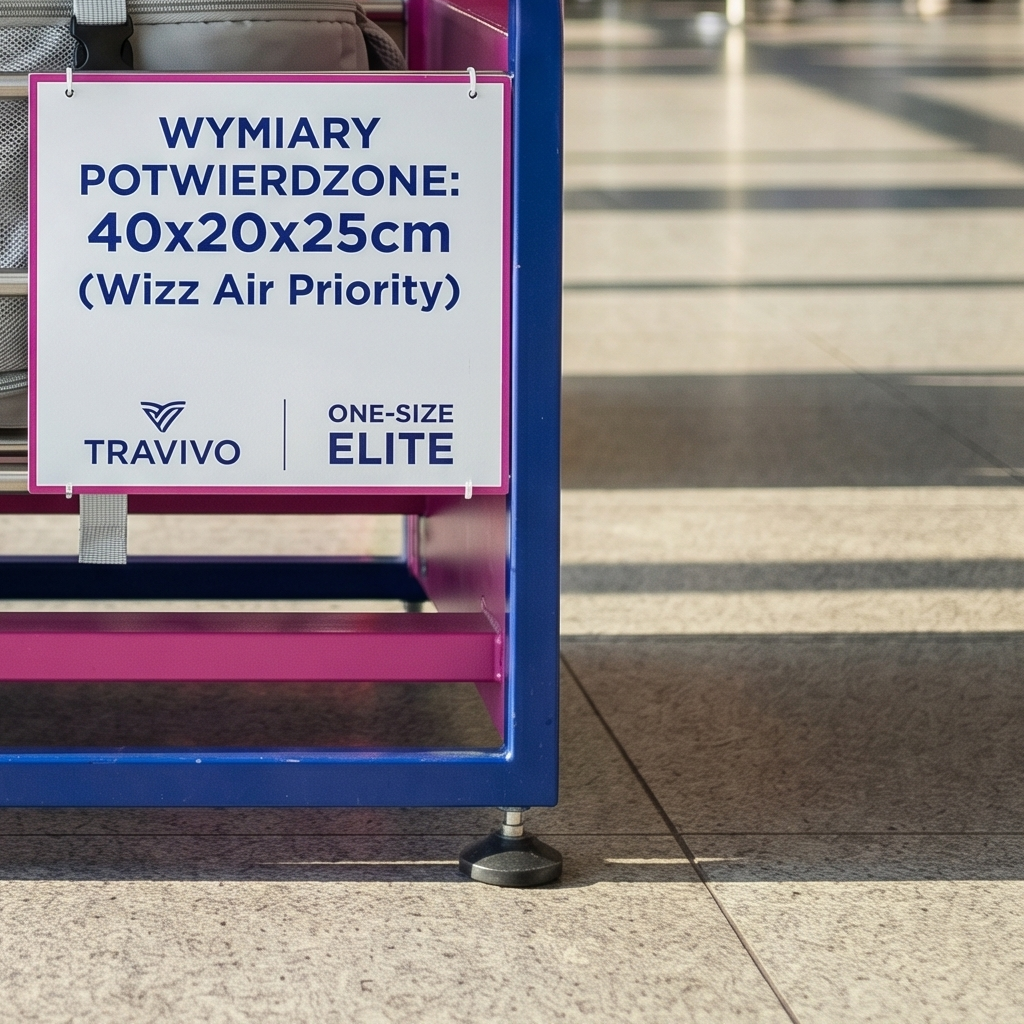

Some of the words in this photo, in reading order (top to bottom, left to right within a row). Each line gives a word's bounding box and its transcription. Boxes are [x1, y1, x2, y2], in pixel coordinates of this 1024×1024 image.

[159, 117, 381, 149] WYMIARY
[80, 164, 460, 197] POTWIERDZONE:
[87, 212, 451, 253] 40x20x25cm
[79, 272, 199, 310] (Wizz
[213, 273, 274, 305] Air
[289, 273, 460, 312] Priority)
[328, 404, 454, 423] ONE-SIZE
[84, 440, 241, 465] TRAVIVO
[329, 432, 454, 465] ELITE
